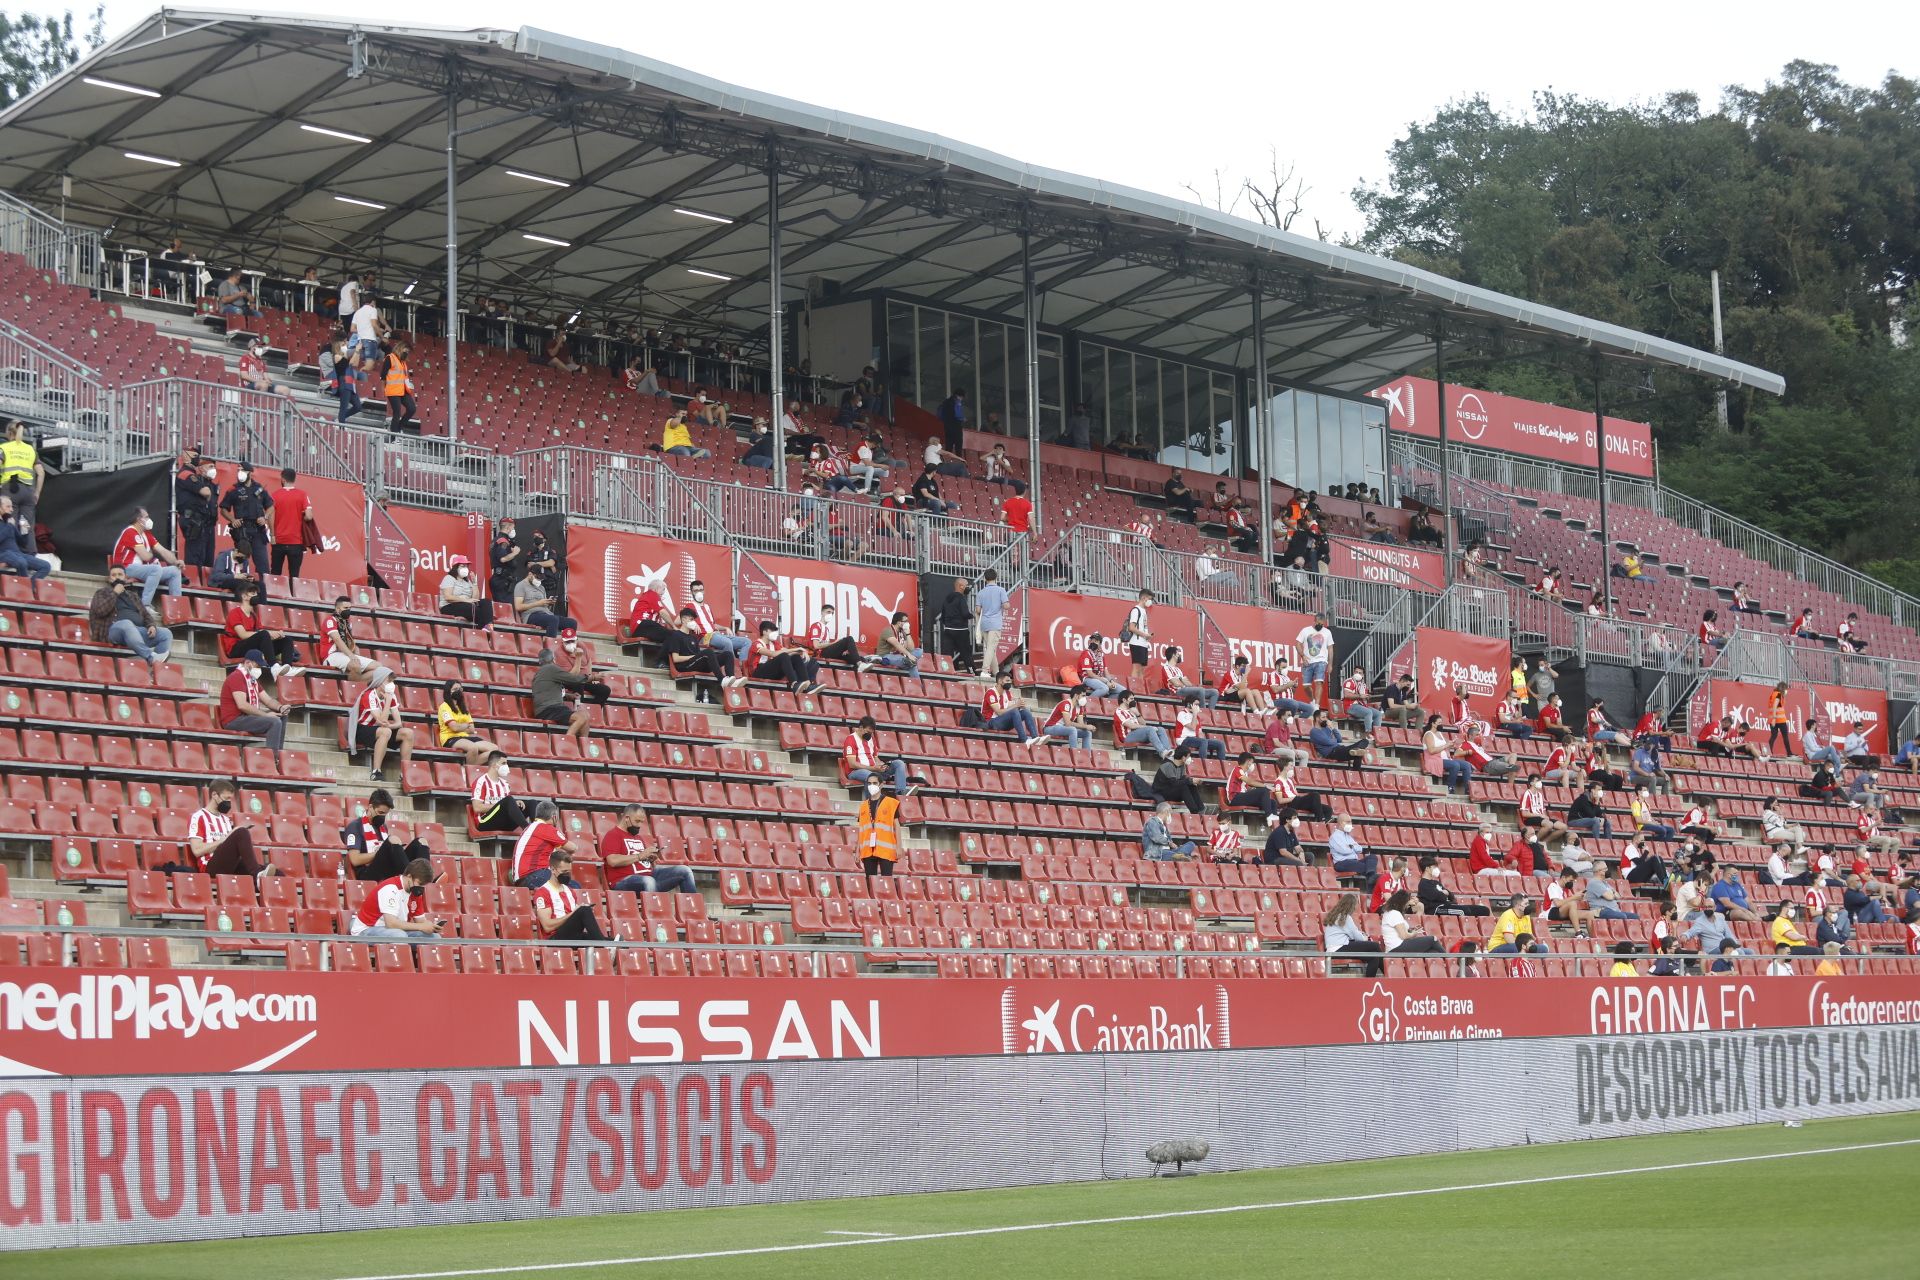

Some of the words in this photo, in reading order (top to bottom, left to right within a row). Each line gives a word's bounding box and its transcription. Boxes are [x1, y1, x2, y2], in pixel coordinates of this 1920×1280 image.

[1456, 410, 1488, 423] NISSAN
[1514, 422, 1537, 434] VIAJES
[1585, 430, 1630, 455] GIONA
[1632, 440, 1647, 458] FC
[468, 514, 475, 525] B
[477, 514, 484, 525] B
[1350, 545, 1410, 568] BENVINGUTS
[1412, 555, 1420, 570] A
[768, 574, 860, 643] UMA
[1450, 661, 1468, 680] Leo
[1469, 664, 1497, 685] Boeck
[1404, 995, 1438, 1015] Costa
[1440, 995, 1474, 1015] Brava
[1590, 986, 1710, 1035] GIRONA
[1720, 985, 1757, 1030] FC
[518, 999, 881, 1066] NISSAN
[1070, 1004, 1213, 1052] CaixaBank
[1405, 1025, 1446, 1041] Pirineu
[1449, 1025, 1463, 1040] de
[1466, 1024, 1502, 1039] Girona
[1575, 1036, 1749, 1126] DESCOBREIX
[1753, 1032, 1822, 1111] TOTS
[1828, 1031, 1870, 1105] ELS
